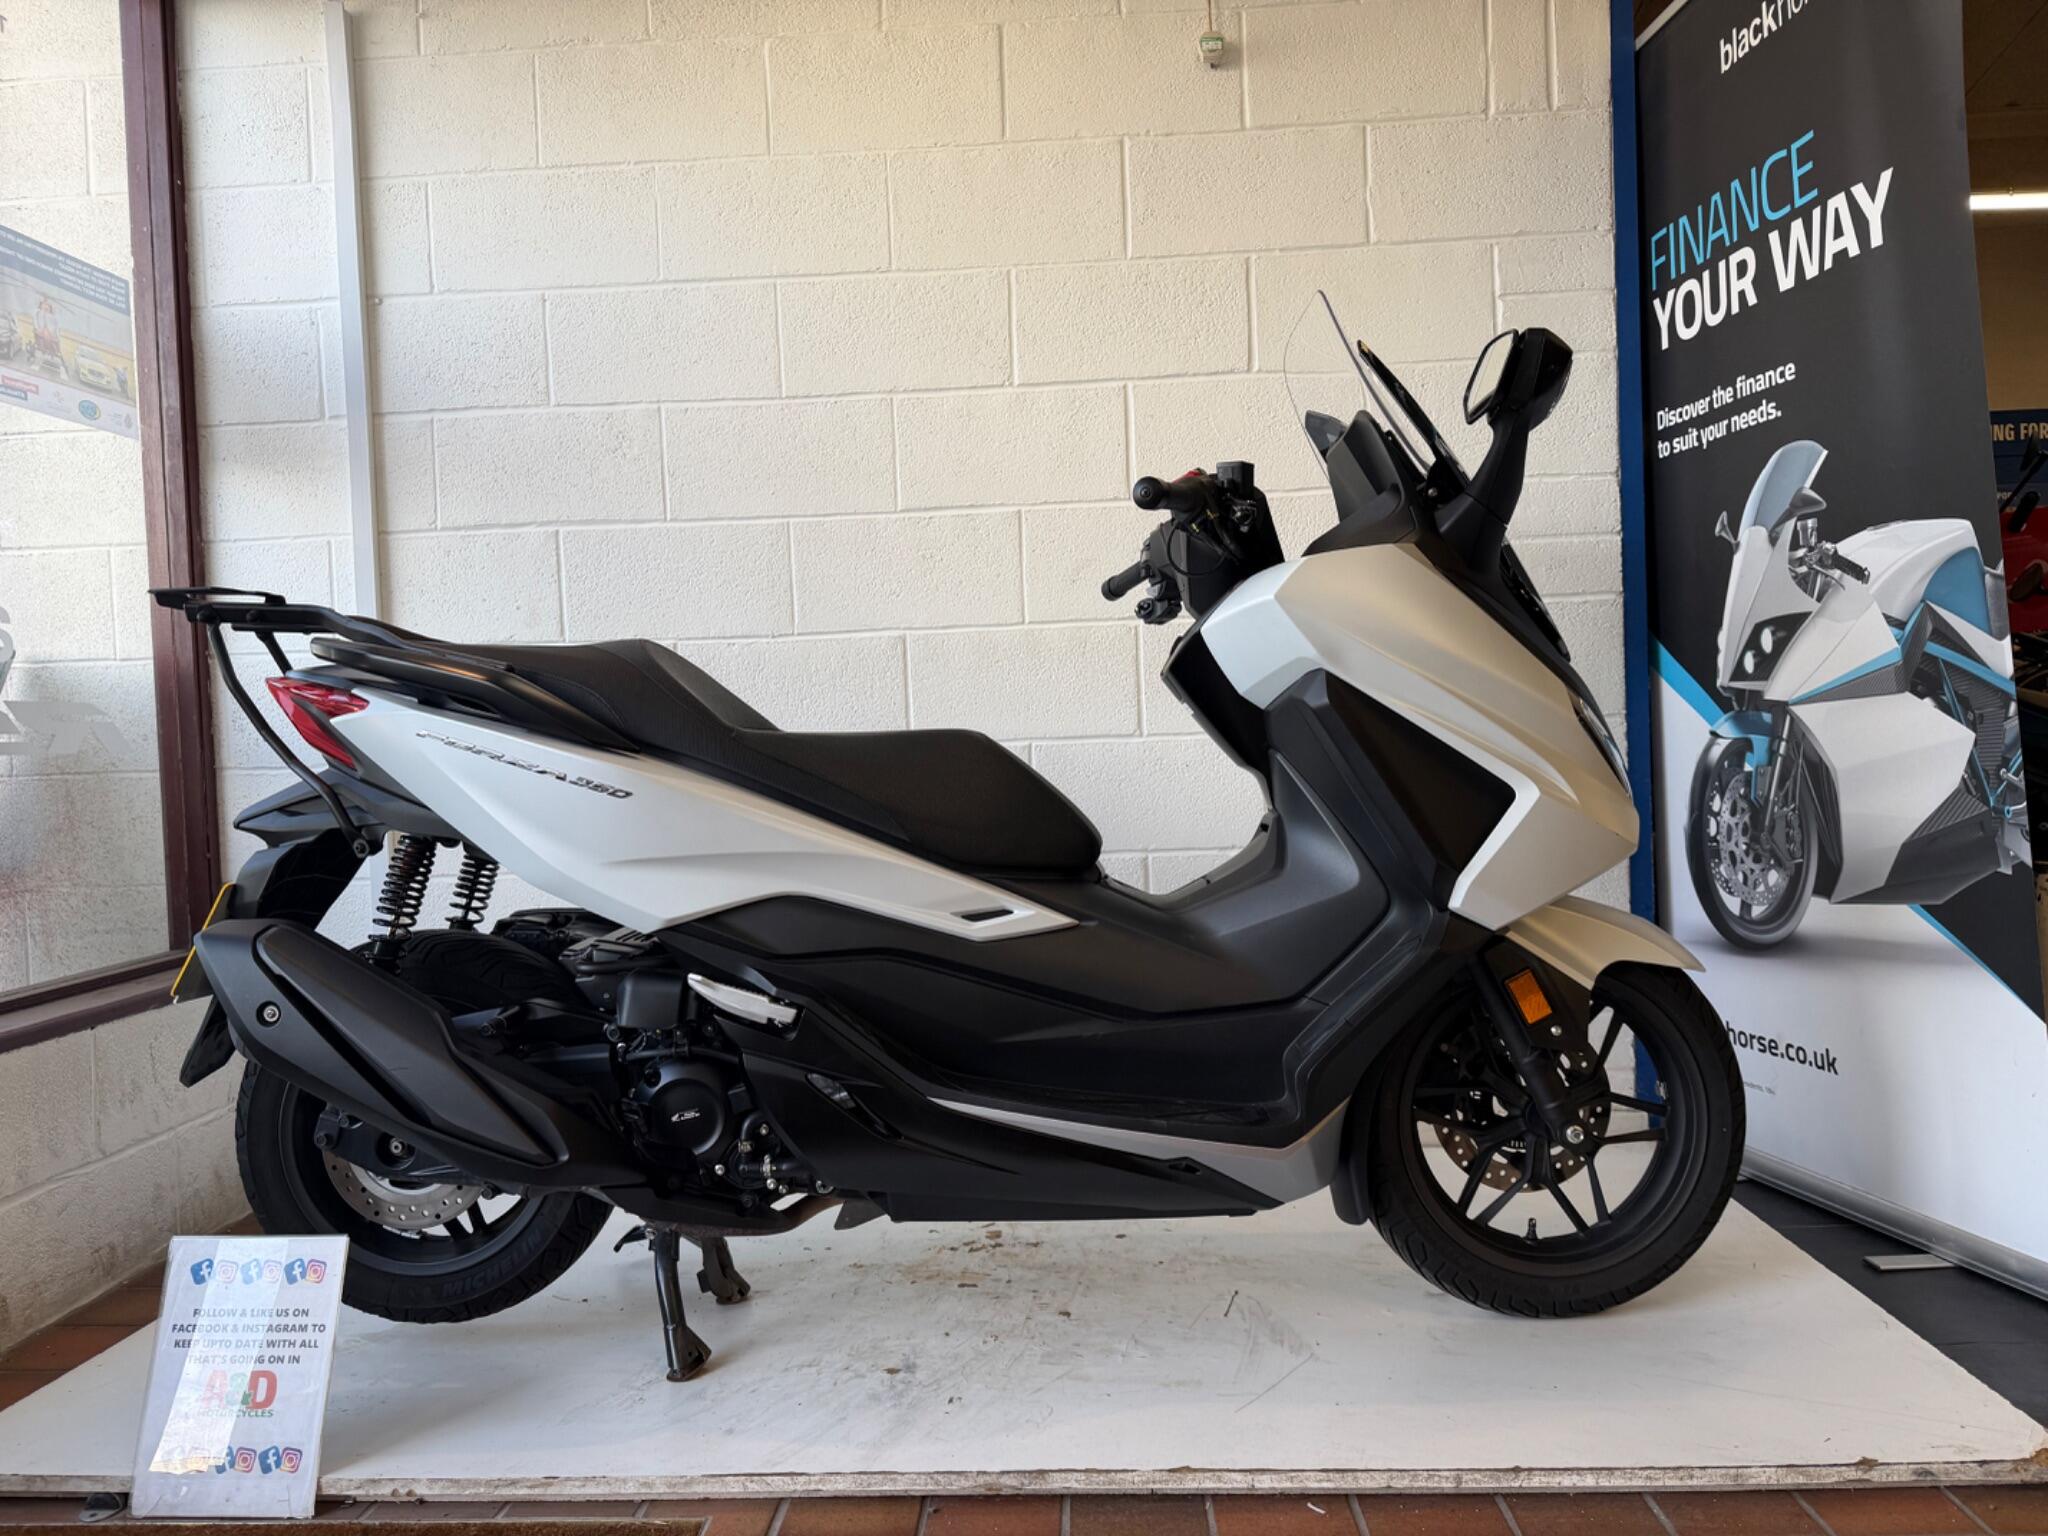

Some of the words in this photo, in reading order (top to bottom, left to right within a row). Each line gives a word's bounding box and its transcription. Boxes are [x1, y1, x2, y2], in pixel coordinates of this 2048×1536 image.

[1650, 129, 1819, 291] FINANCE
[1652, 246, 1758, 351] YOUR
[1768, 167, 1894, 293] WAY
[1656, 395, 1711, 431] Discover
[1712, 385, 1735, 409] the
[1736, 362, 1796, 399] finance
[1657, 440, 1671, 459] to
[1672, 427, 1699, 454] suit
[1700, 418, 1729, 450] your
[1730, 399, 1782, 433] needs.
[441, 1226, 544, 1298] MICHELIN
[171, 1324, 229, 1333] FACEBOOK
[241, 1324, 309, 1333] INSTAGRAM
[311, 1324, 327, 1333] TO
[192, 1308, 238, 1318] FOLLOW
[250, 1308, 274, 1318] LIKE
[276, 1308, 290, 1318] US
[292, 1308, 310, 1318] ON
[173, 1339, 200, 1349] KEEP
[234, 1339, 263, 1349] DATE
[266, 1339, 297, 1349] WITH
[298, 1339, 319, 1349] ALL
[188, 1355, 227, 1364] THAT'S
[229, 1355, 265, 1364] GOING
[267, 1355, 286, 1364] ON
[287, 1355, 301, 1364] IN
